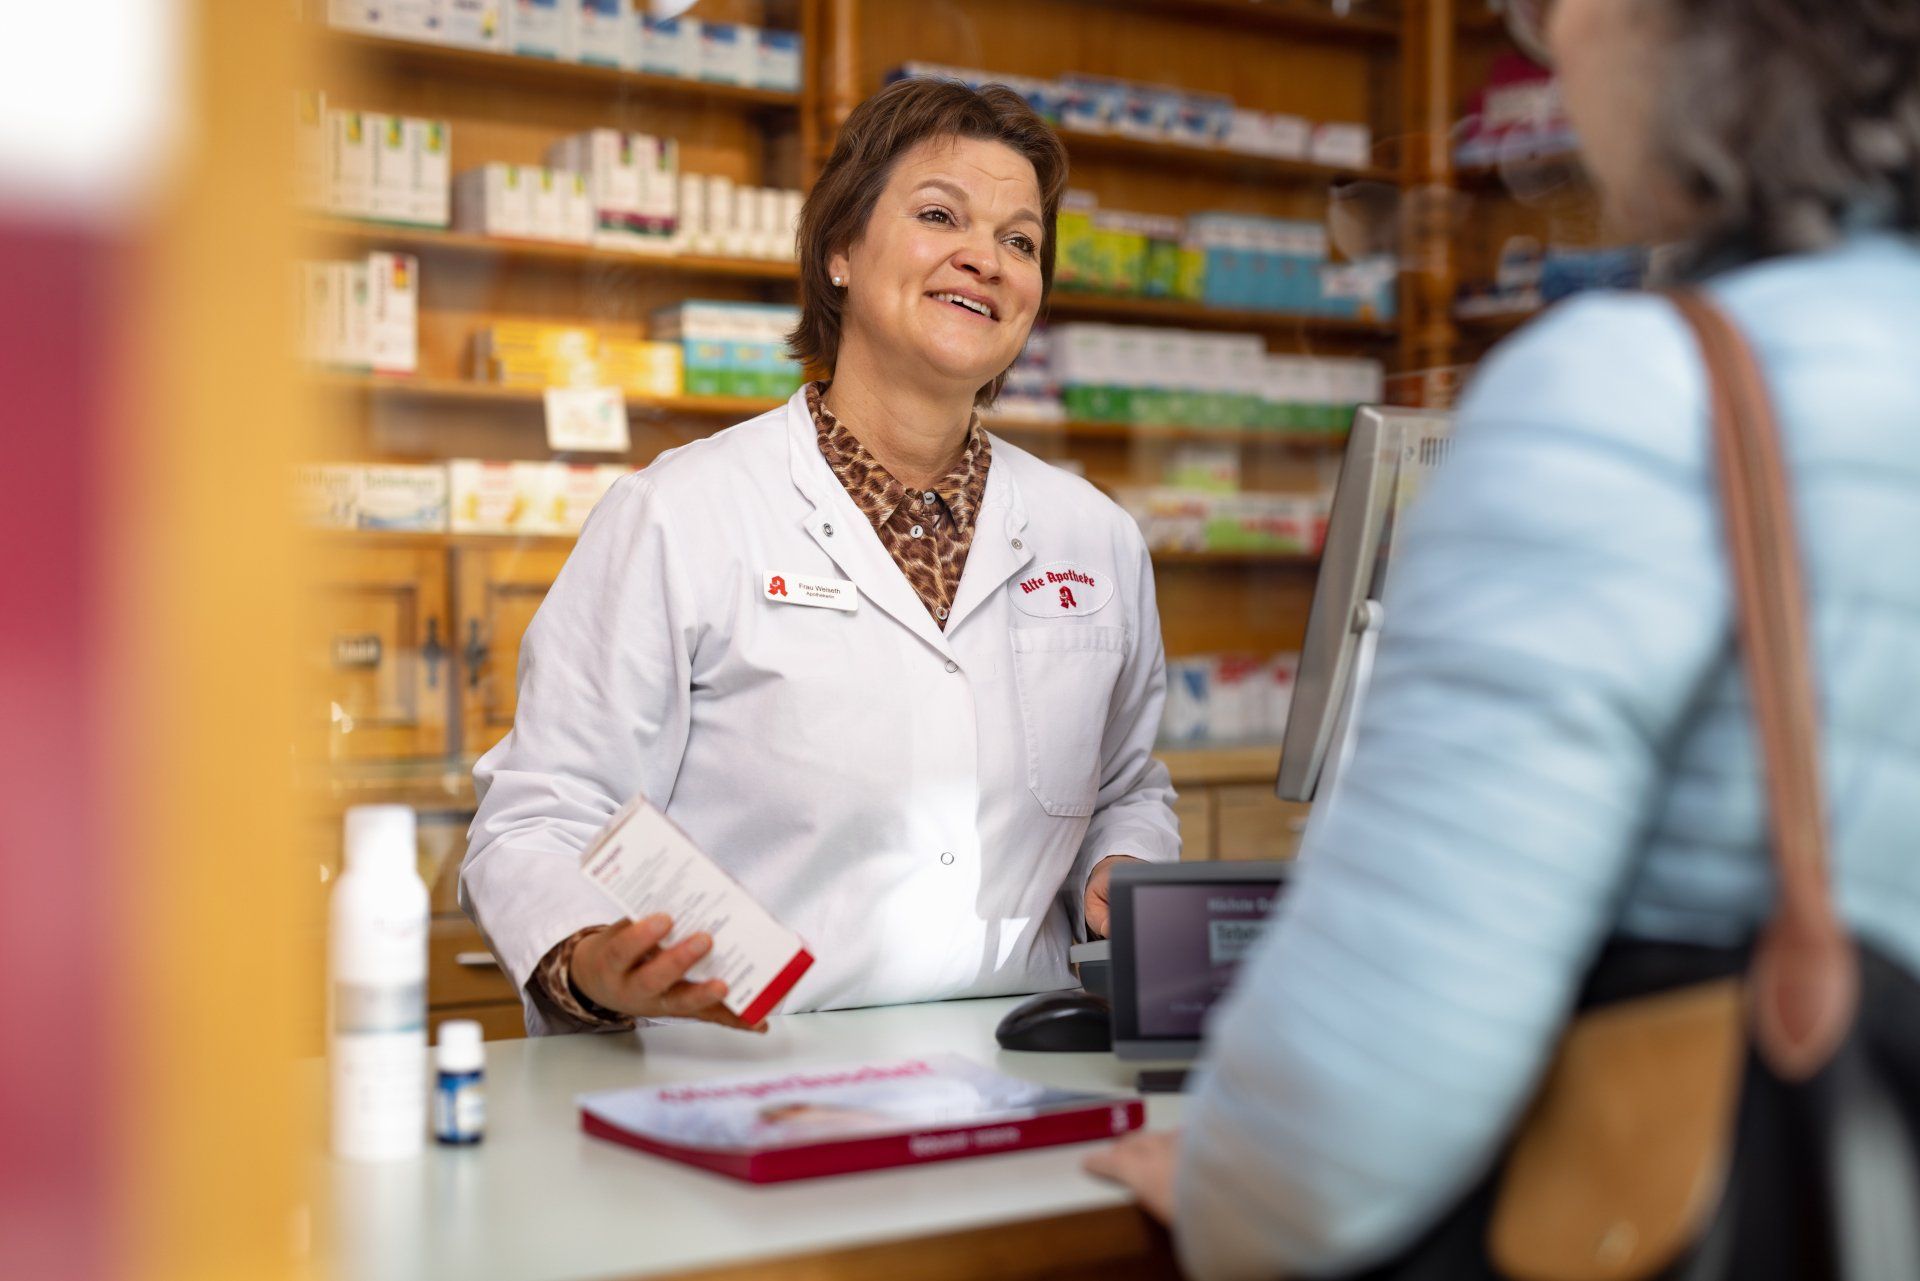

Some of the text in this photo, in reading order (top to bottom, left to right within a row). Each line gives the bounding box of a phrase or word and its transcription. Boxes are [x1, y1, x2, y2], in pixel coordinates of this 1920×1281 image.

[798, 583, 813, 591] Frau
[1020, 569, 1095, 594] Alte Apotheke
